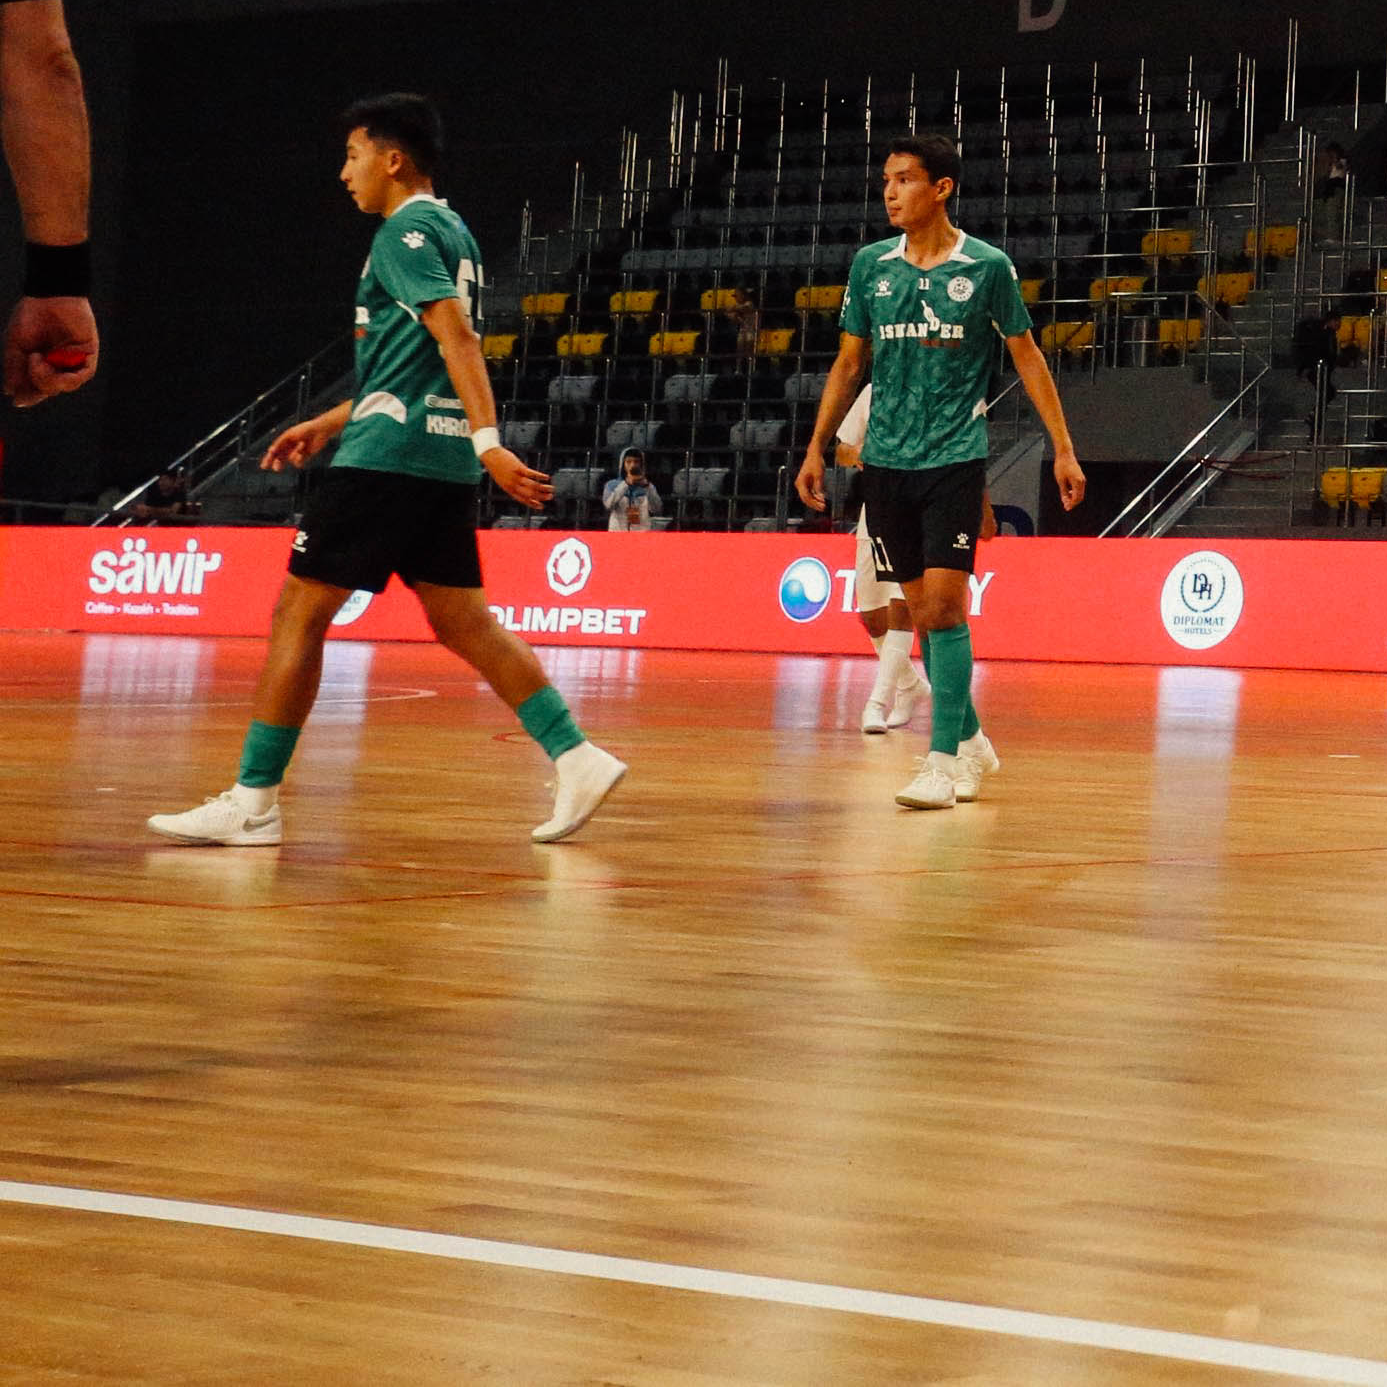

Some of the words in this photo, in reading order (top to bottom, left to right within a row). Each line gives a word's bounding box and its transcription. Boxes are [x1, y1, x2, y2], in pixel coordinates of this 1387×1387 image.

[426, 413, 472, 438] KHRO
[89, 537, 222, 595] säwir
[1173, 616, 1225, 626] DIPLOMAT
